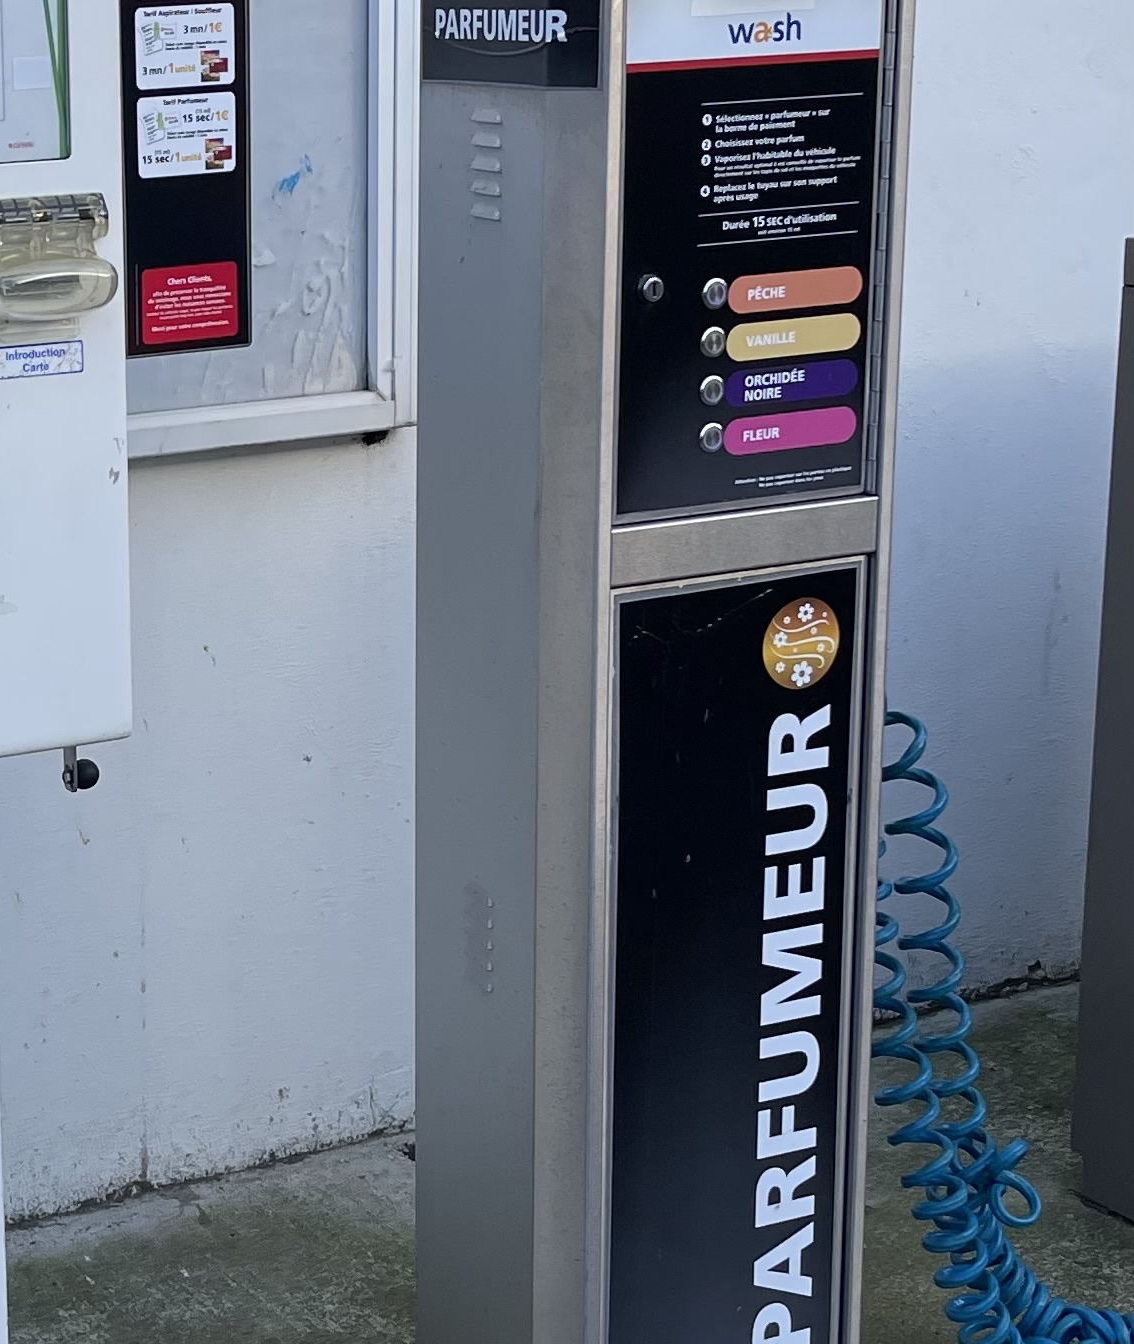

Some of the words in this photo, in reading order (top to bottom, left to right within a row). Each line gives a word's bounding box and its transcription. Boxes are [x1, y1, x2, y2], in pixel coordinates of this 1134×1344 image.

[435, 8, 568, 43] PARFUMEUR
[728, 12, 801, 44] wash
[722, 219, 749, 230] Durée
[752, 215, 764, 227] 15
[766, 215, 782, 226] SEC
[784, 212, 836, 224] d'utilisation
[748, 285, 785, 300] PÊCHE
[746, 330, 796, 348] VANILLE
[6, 348, 66, 360] Introduction
[22, 362, 49, 372] Carte
[745, 367, 804, 387] ORCHIDÉE
[744, 386, 781, 401] NOIRE
[743, 426, 779, 442] FLEUR
